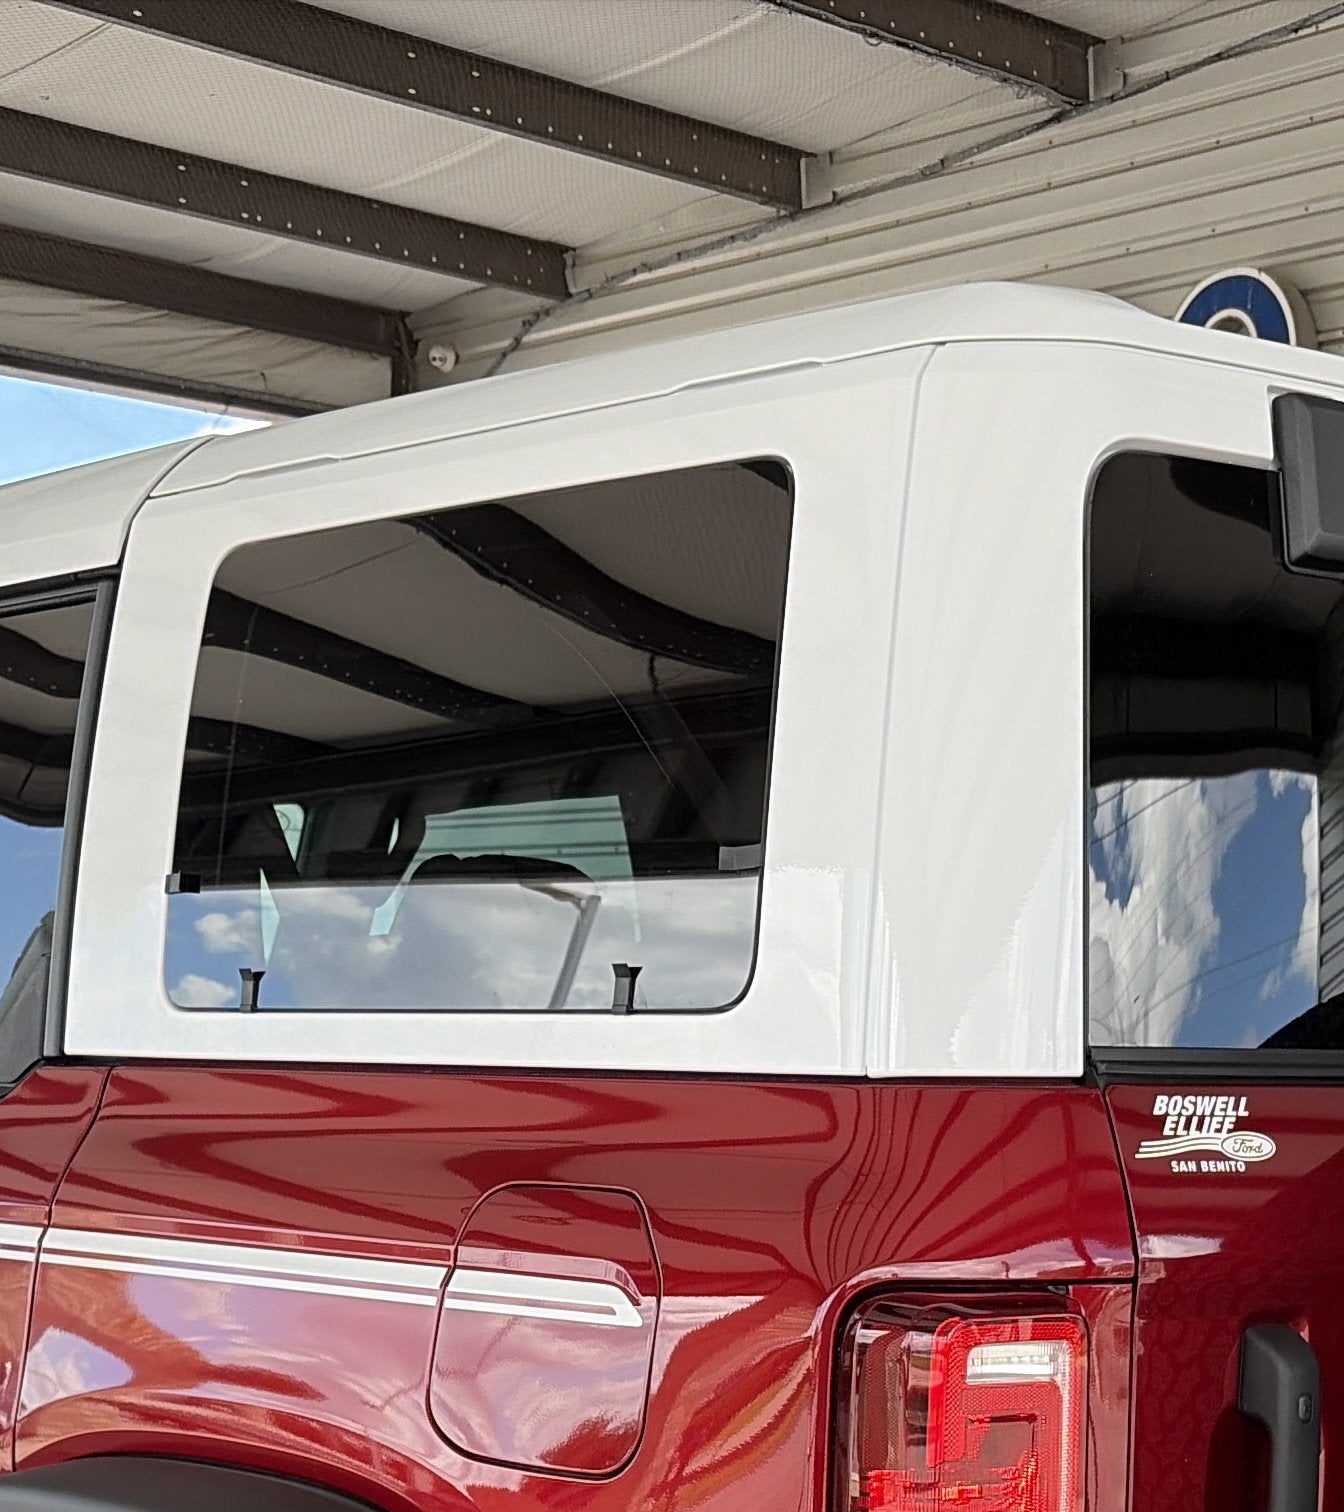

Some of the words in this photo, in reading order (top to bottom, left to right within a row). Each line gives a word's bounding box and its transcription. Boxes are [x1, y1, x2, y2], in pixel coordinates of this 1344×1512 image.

[1153, 1095, 1249, 1117] BOSWELL
[1163, 1115, 1236, 1136] ELLIFF
[1232, 1137, 1264, 1155] Ford
[1171, 1160, 1197, 1173] SAN
[1201, 1160, 1246, 1173] BENITO
